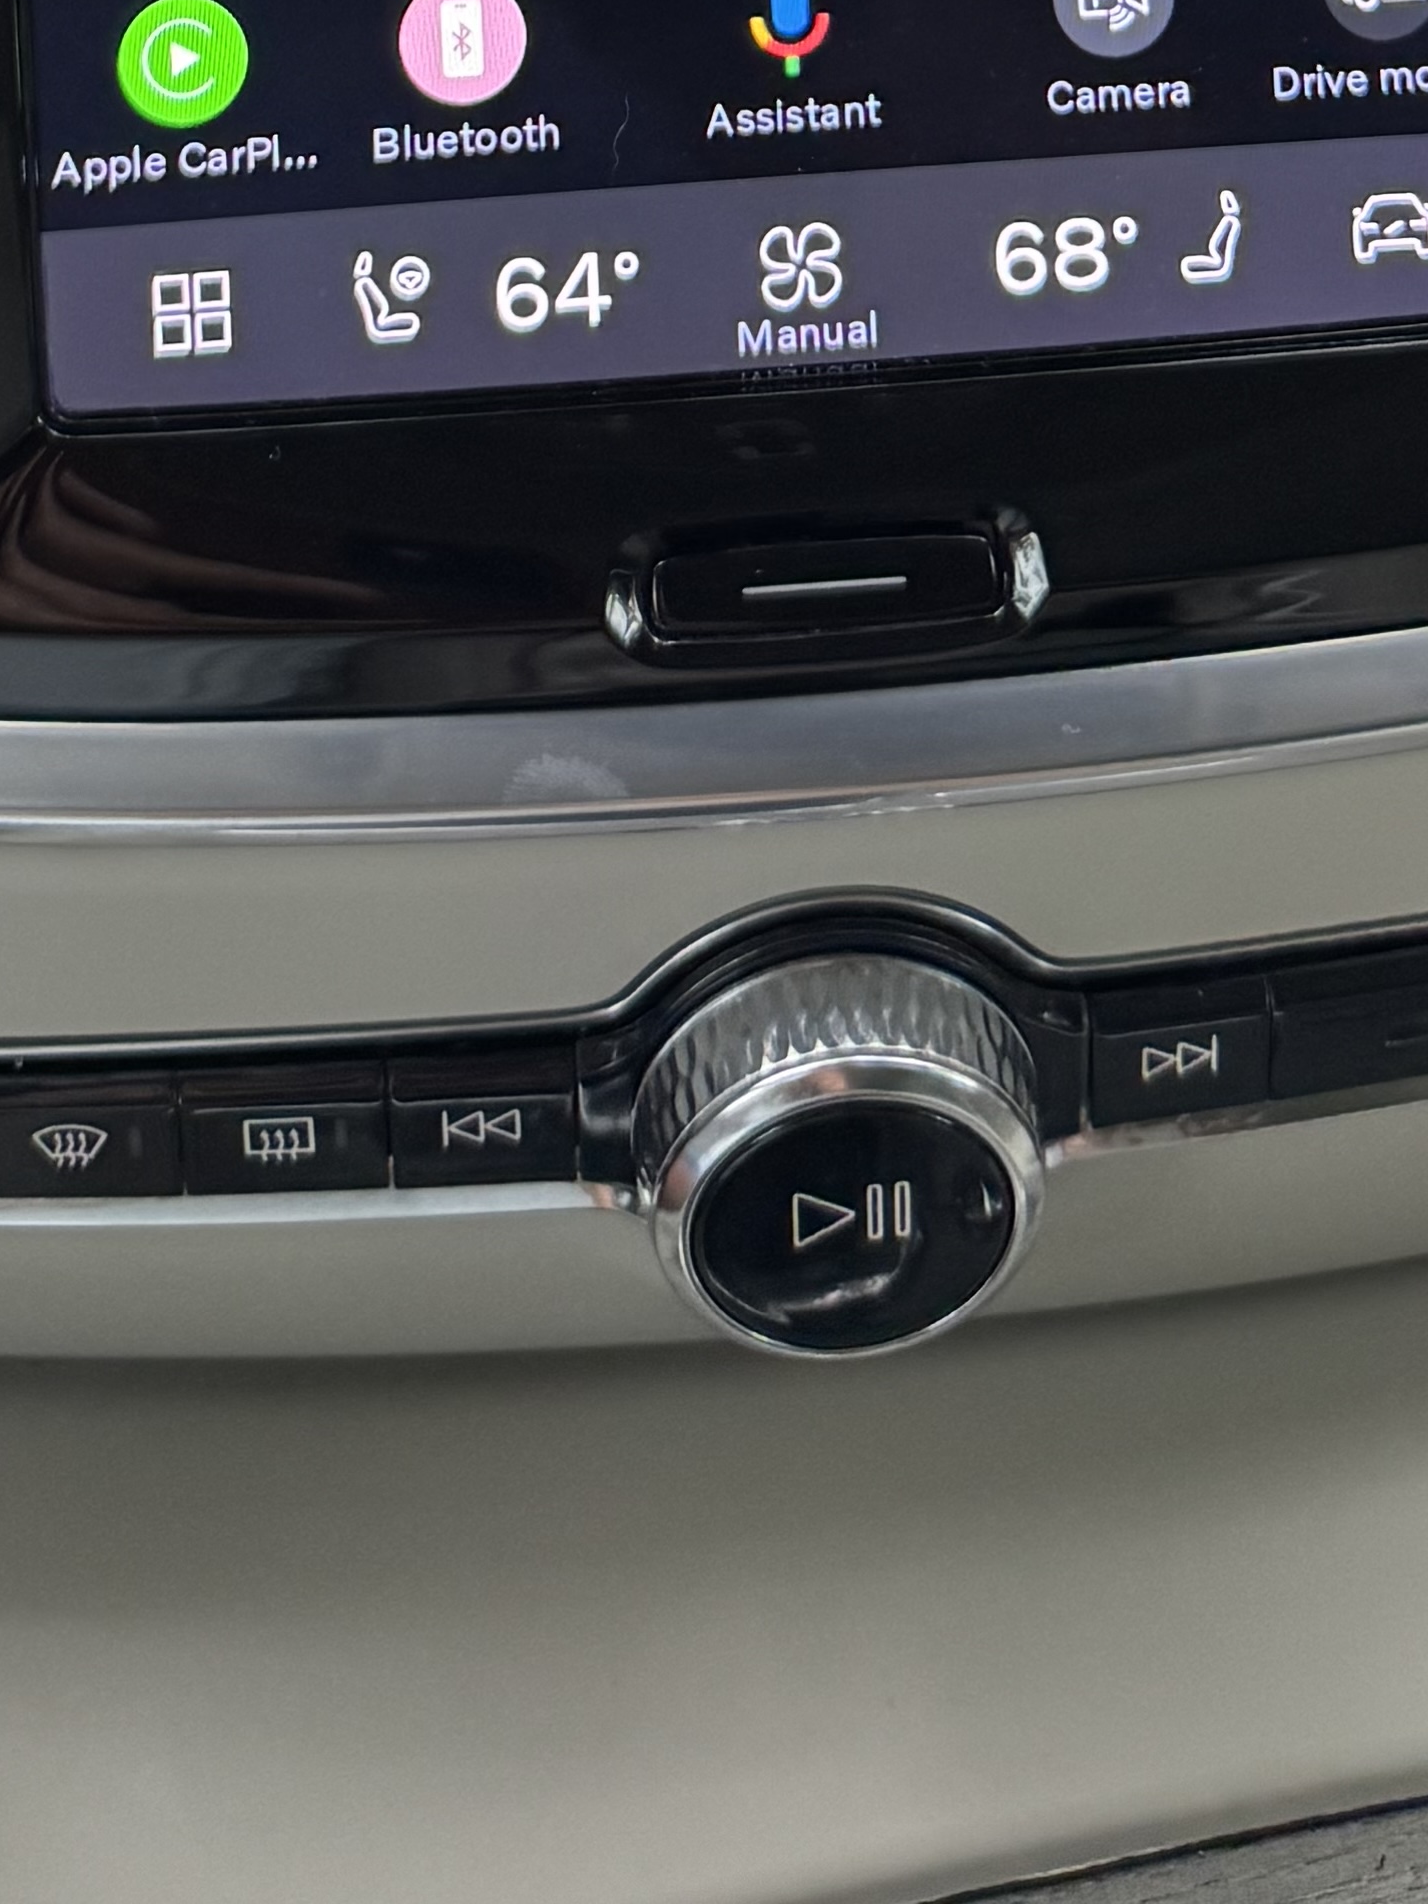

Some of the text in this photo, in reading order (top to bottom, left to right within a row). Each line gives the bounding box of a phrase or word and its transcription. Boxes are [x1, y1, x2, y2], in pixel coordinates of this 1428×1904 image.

[1046, 80, 1192, 115] Camera
[1272, 65, 1370, 102] Drive
[706, 92, 883, 137] Assistant
[373, 115, 561, 165] Bluetooth
[51, 145, 166, 195] Apple
[994, 215, 1139, 296] 68°
[495, 250, 640, 333] 64°
[736, 310, 879, 358] Manual
